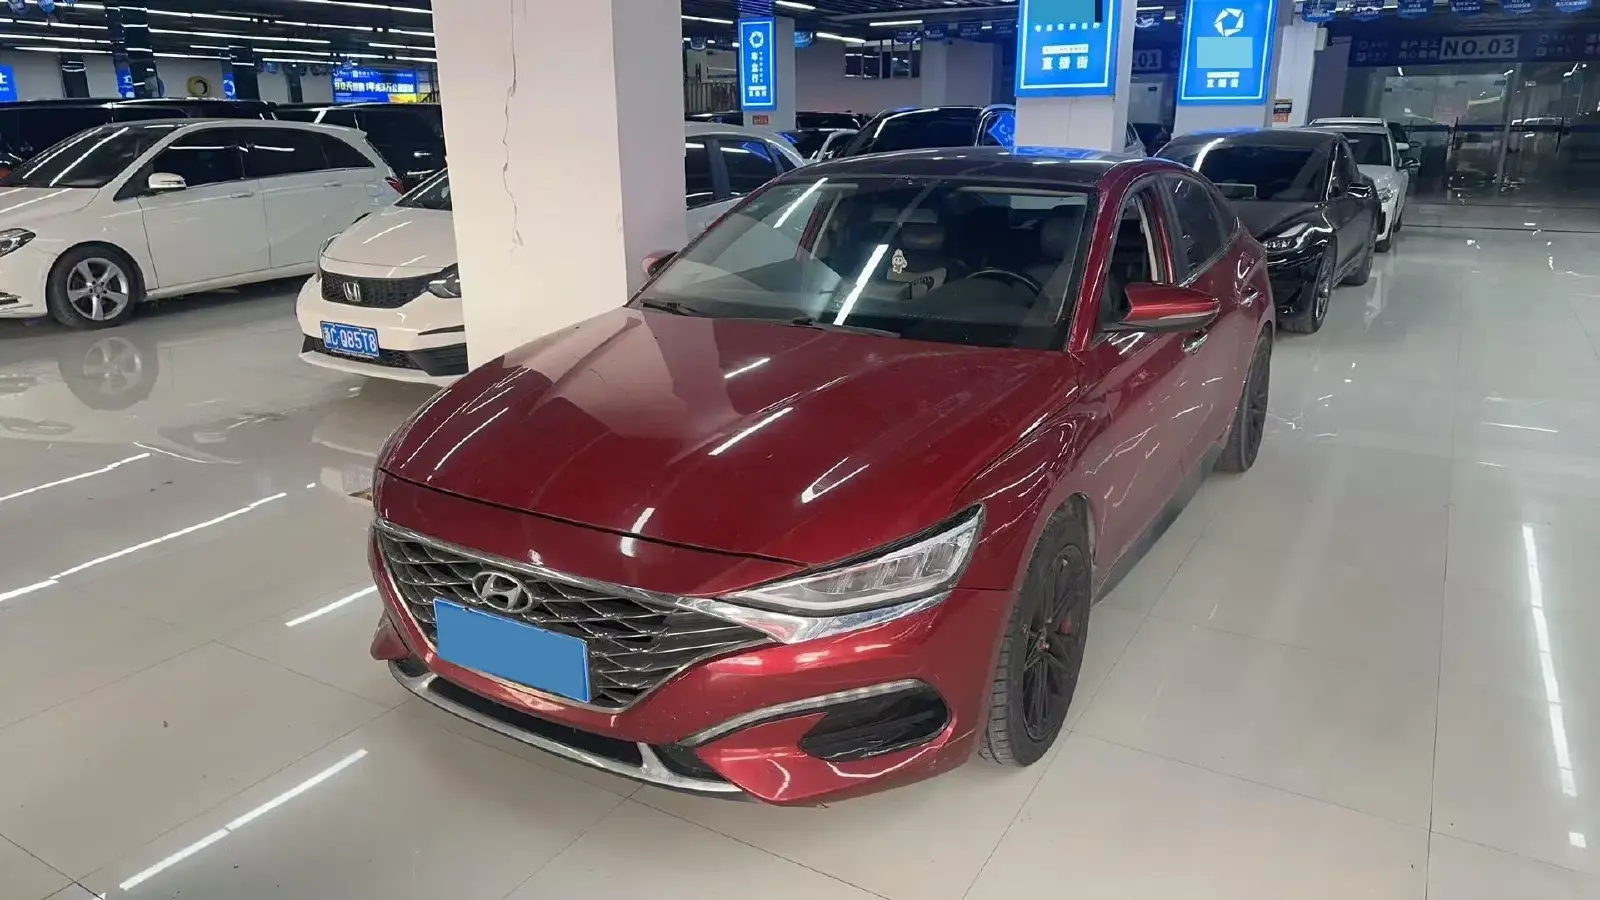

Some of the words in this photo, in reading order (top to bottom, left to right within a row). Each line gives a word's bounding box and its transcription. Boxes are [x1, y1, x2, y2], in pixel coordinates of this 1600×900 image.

[1443, 38, 1516, 56] NO.03
[1041, 55, 1089, 70] 直播街
